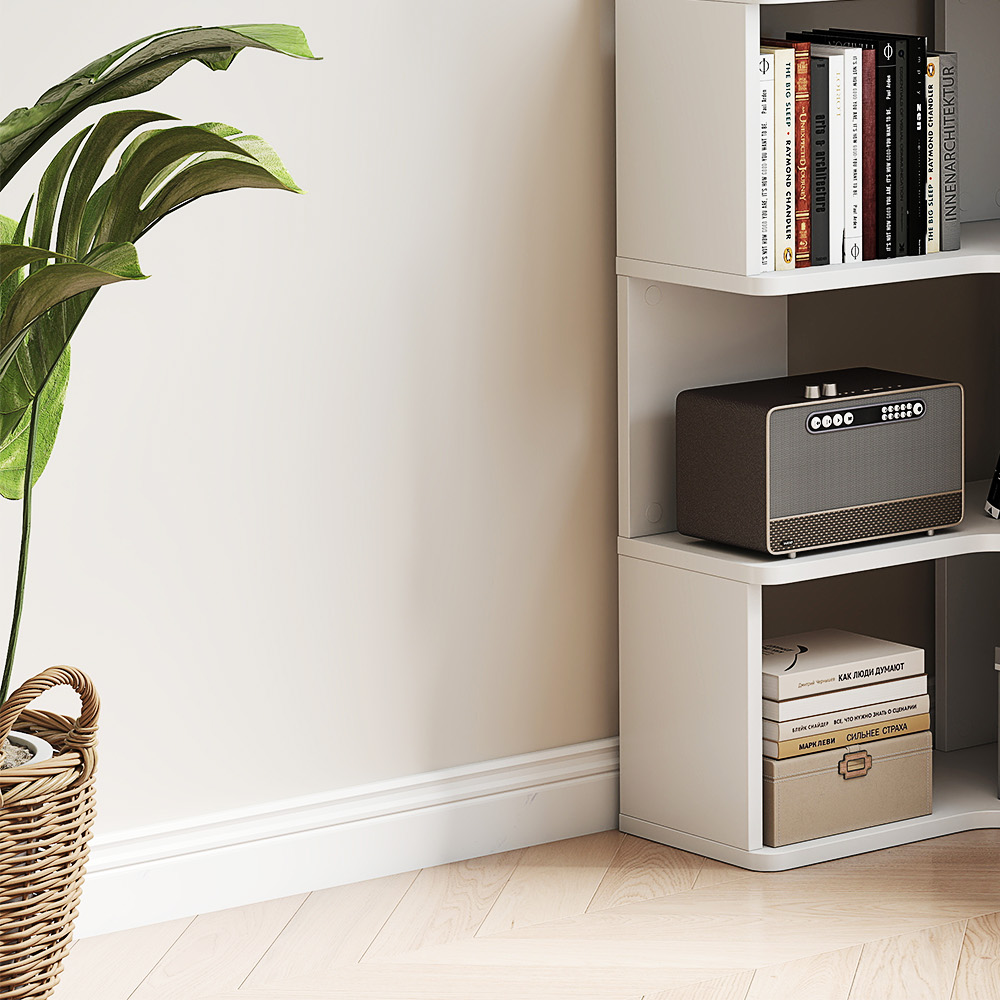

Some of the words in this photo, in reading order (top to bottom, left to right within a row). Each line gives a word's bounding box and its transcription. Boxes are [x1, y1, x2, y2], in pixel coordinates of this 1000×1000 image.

[814, 114, 826, 134] arts
[943, 66, 957, 222] INNENARCHITEKTUR
[814, 150, 826, 212] architecture
[838, 673, 852, 682] КАК
[853, 669, 874, 679] ЛЮДИ
[875, 662, 904, 676] ДУМАЮТ
[846, 728, 880, 742] СИЛЬНЕЕ
[882, 722, 908, 734] СТРАХА
[799, 741, 817, 750] МАРК
[818, 738, 836, 746] ЛЕВИ
